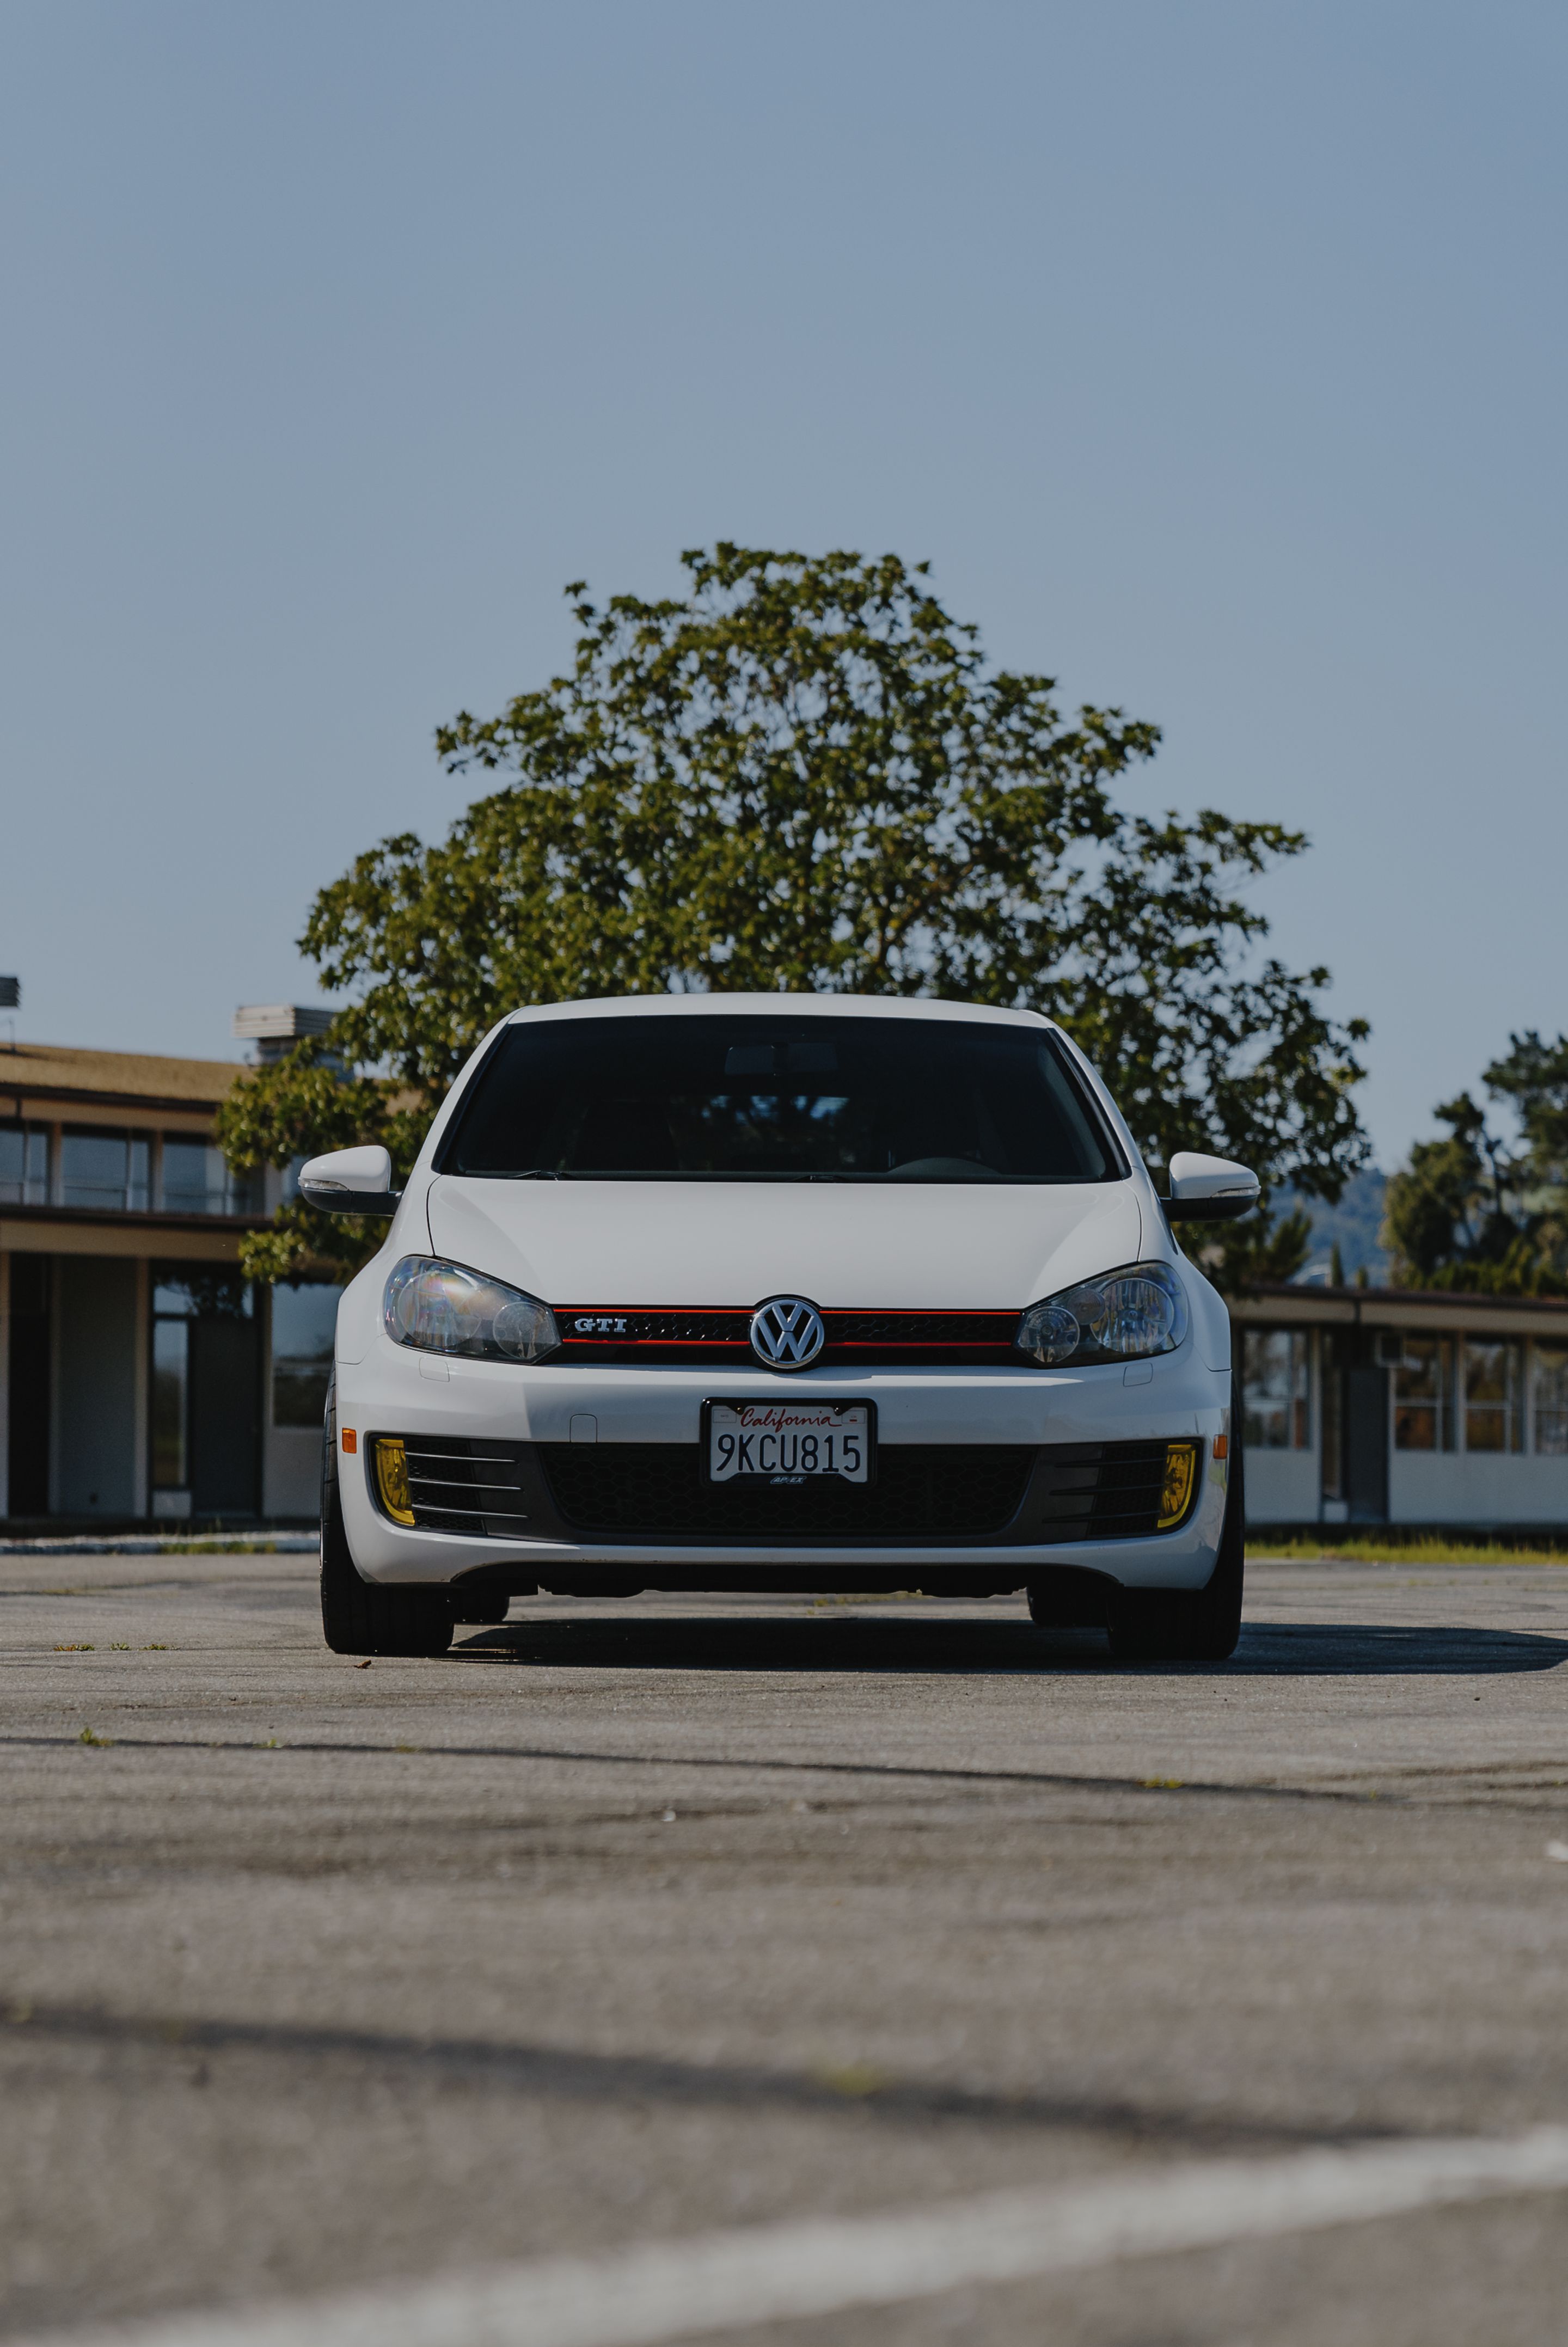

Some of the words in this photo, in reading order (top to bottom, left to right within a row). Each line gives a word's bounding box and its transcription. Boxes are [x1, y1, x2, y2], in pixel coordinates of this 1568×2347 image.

[575, 1318, 627, 1332] GTI
[755, 1303, 817, 1362] VW
[740, 1408, 842, 1433] California
[716, 1434, 861, 1472] 9KCU815
